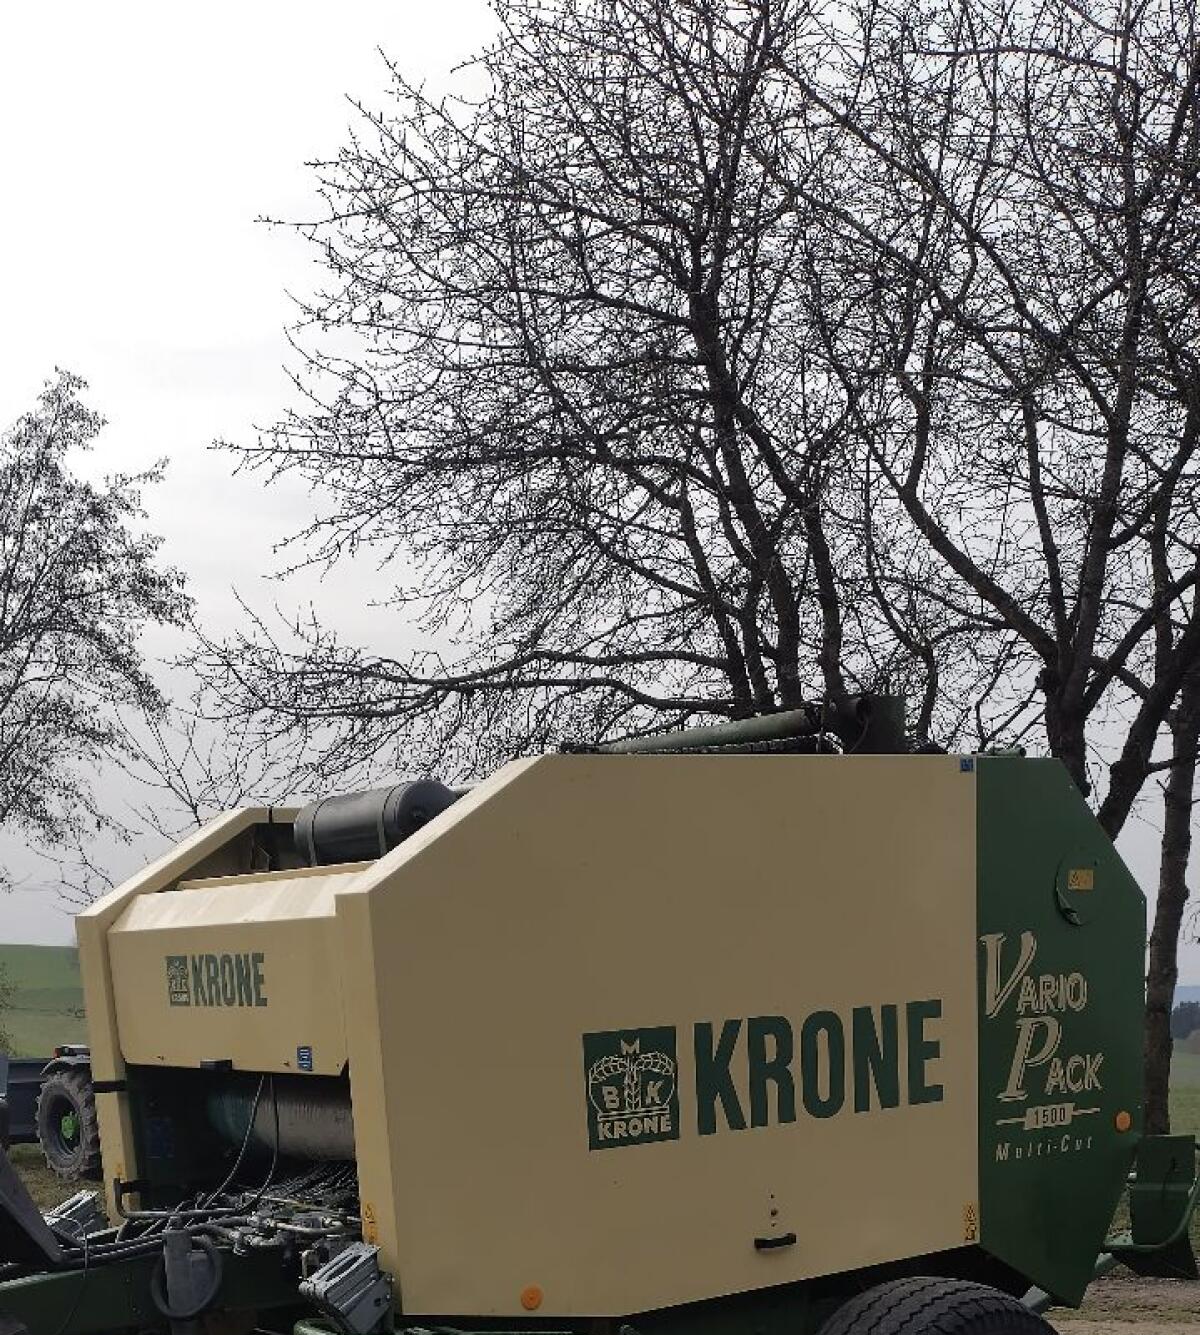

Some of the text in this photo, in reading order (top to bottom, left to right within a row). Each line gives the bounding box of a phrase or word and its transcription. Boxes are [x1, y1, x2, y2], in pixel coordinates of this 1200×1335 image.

[191, 952, 268, 1007] KRONE
[979, 931, 1088, 1019] VARIO
[694, 999, 943, 1135] KRONE
[996, 1015, 1104, 1102] PACK
[602, 1080, 664, 1109] B K
[598, 1115, 672, 1141] KRONE
[1034, 1107, 1066, 1126] 1500
[996, 1134, 1092, 1162] Multi-Cut
